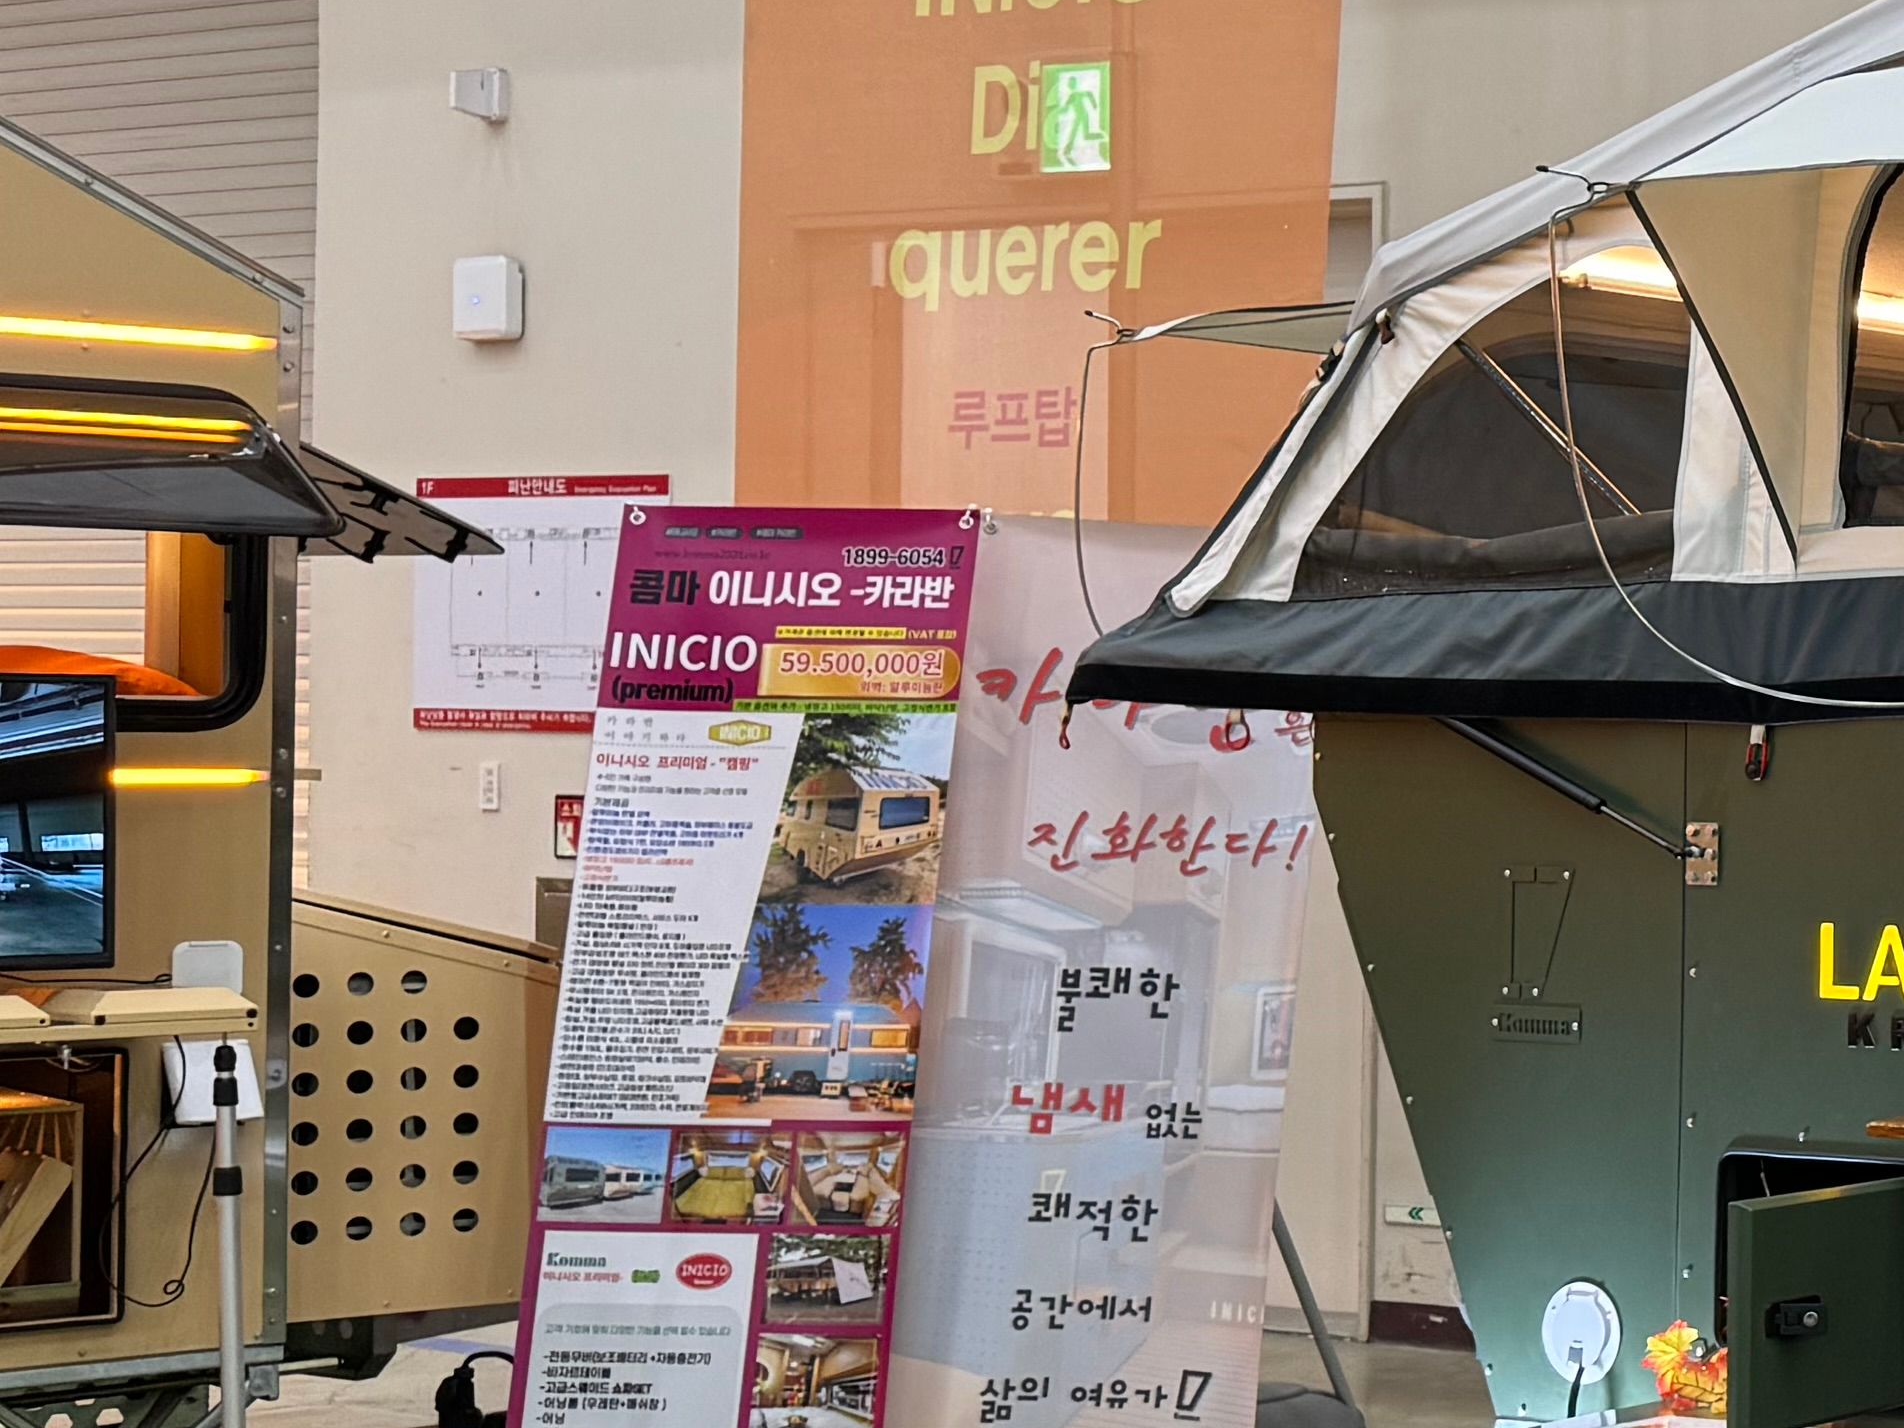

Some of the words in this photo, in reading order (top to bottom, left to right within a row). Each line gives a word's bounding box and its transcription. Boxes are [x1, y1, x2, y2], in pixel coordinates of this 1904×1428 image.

[889, 219, 1161, 312] querer
[948, 385, 1077, 450] 루프탑
[507, 478, 567, 495] 피난안내도
[843, 546, 945, 567] 1899-6054
[630, 569, 699, 605] 콤마
[709, 570, 842, 608] 이니시오
[609, 631, 758, 673] INICIO
[779, 649, 945, 677] 59.500,000원
[612, 678, 733, 704] (premium)
[596, 753, 650, 769] 이니시오
[656, 755, 708, 771] 프리미엄
[1028, 810, 1308, 876] 진화한다!
[1056, 967, 1180, 1032] 불쾌한
[1011, 1082, 1126, 1134] 냄새
[1146, 1102, 1202, 1139] 없는
[1028, 1193, 1158, 1242] 쾌적한
[681, 1263, 729, 1278] INICIO
[1011, 1289, 1152, 1330] 공간에서
[980, 1376, 1050, 1423] 삶의
[1070, 1379, 1168, 1409] 여유가
